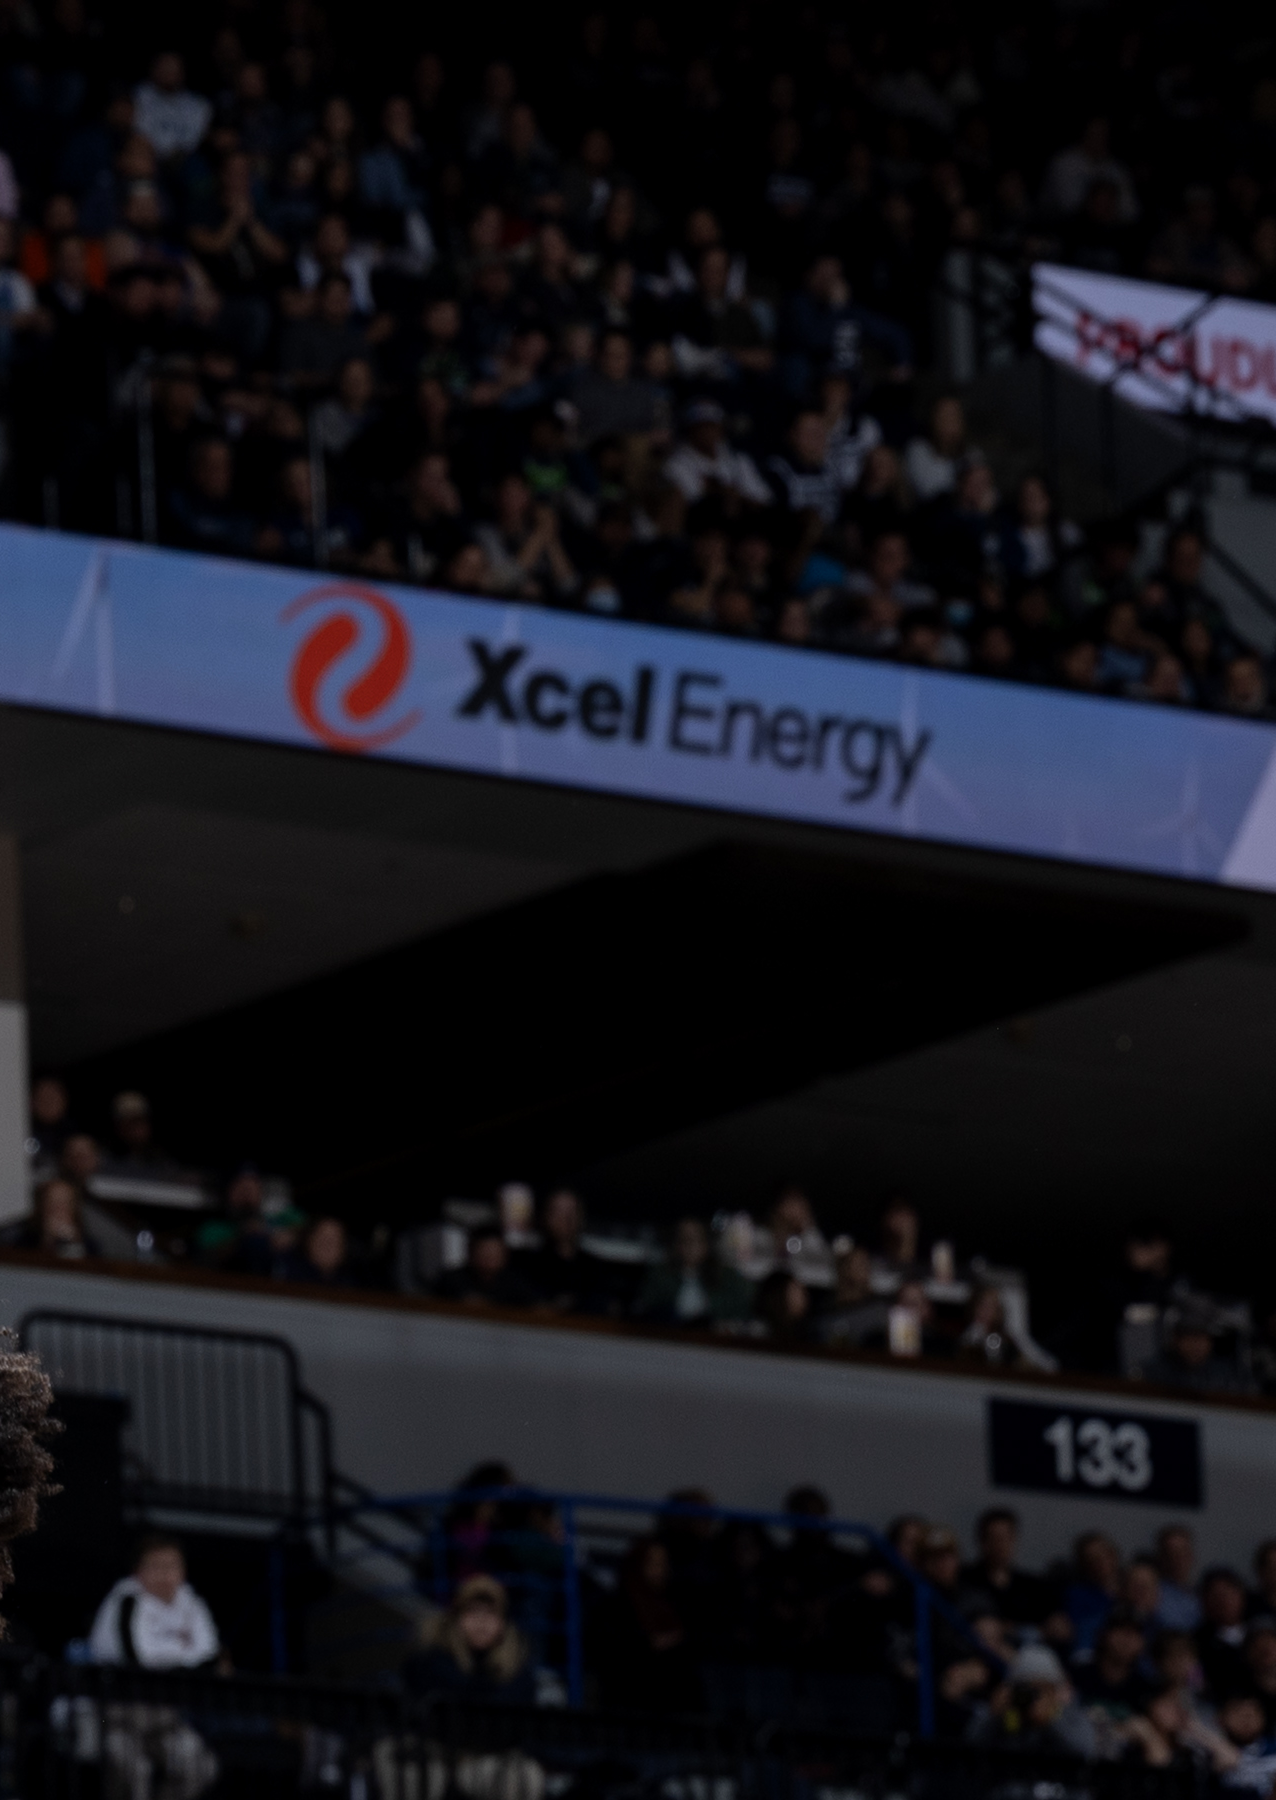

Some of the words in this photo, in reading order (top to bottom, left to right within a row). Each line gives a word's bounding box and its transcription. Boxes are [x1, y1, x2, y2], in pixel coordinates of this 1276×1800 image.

[459, 637, 656, 743] Xcel
[667, 669, 931, 806] Energy
[1041, 1413, 1155, 1494] 133
